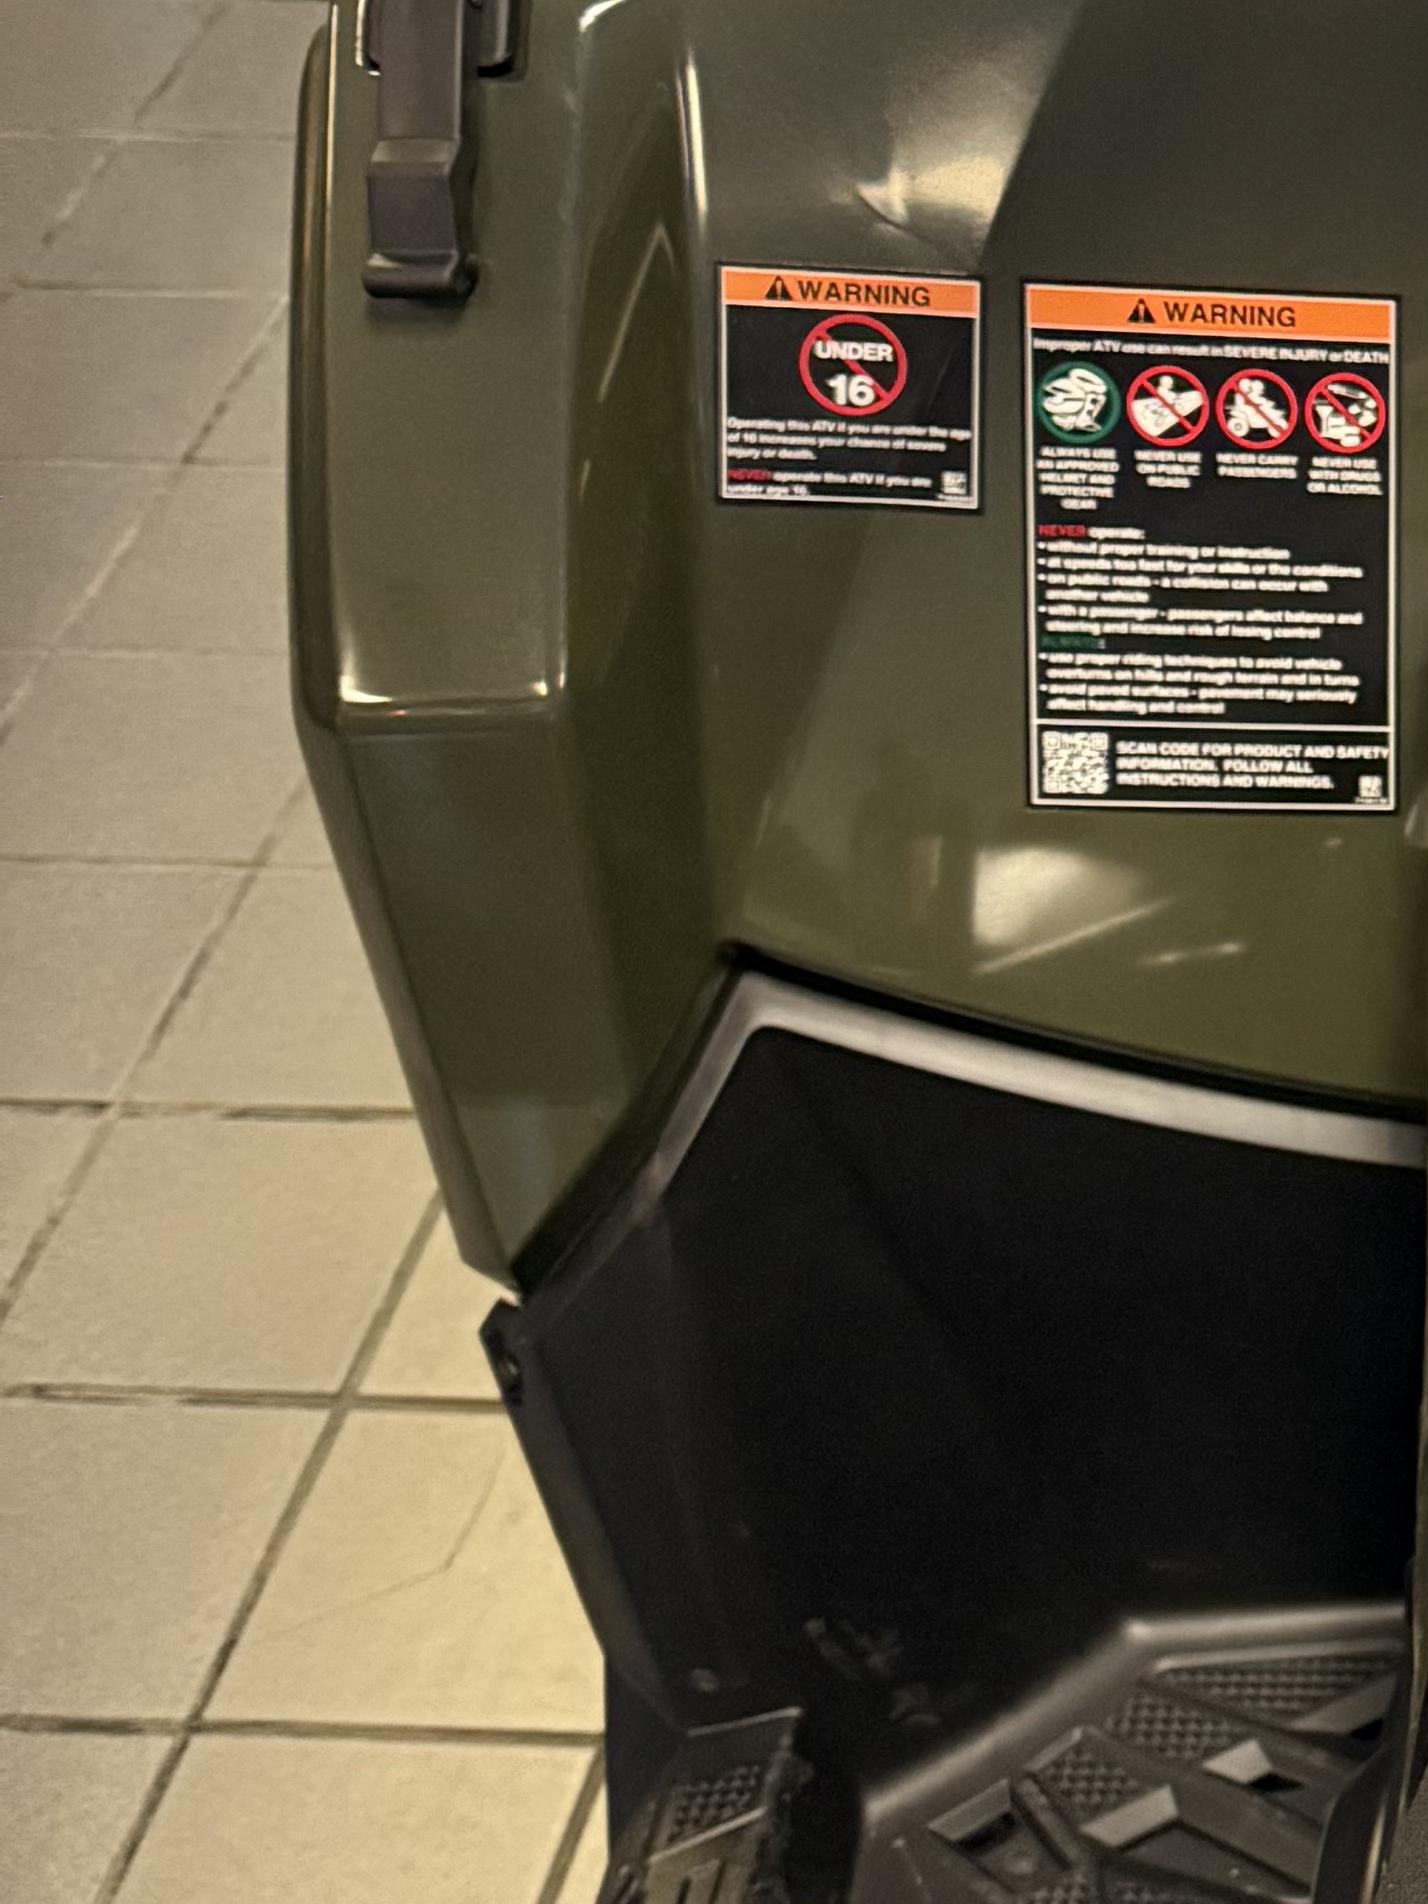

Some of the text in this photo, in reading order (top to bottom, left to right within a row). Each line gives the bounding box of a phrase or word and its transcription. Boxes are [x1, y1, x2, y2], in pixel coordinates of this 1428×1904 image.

[798, 280, 932, 308] WARNING
[1164, 301, 1298, 328] WARNING
[814, 339, 894, 363] UNDER
[1092, 339, 1121, 352] ATV
[825, 372, 877, 407] 16
